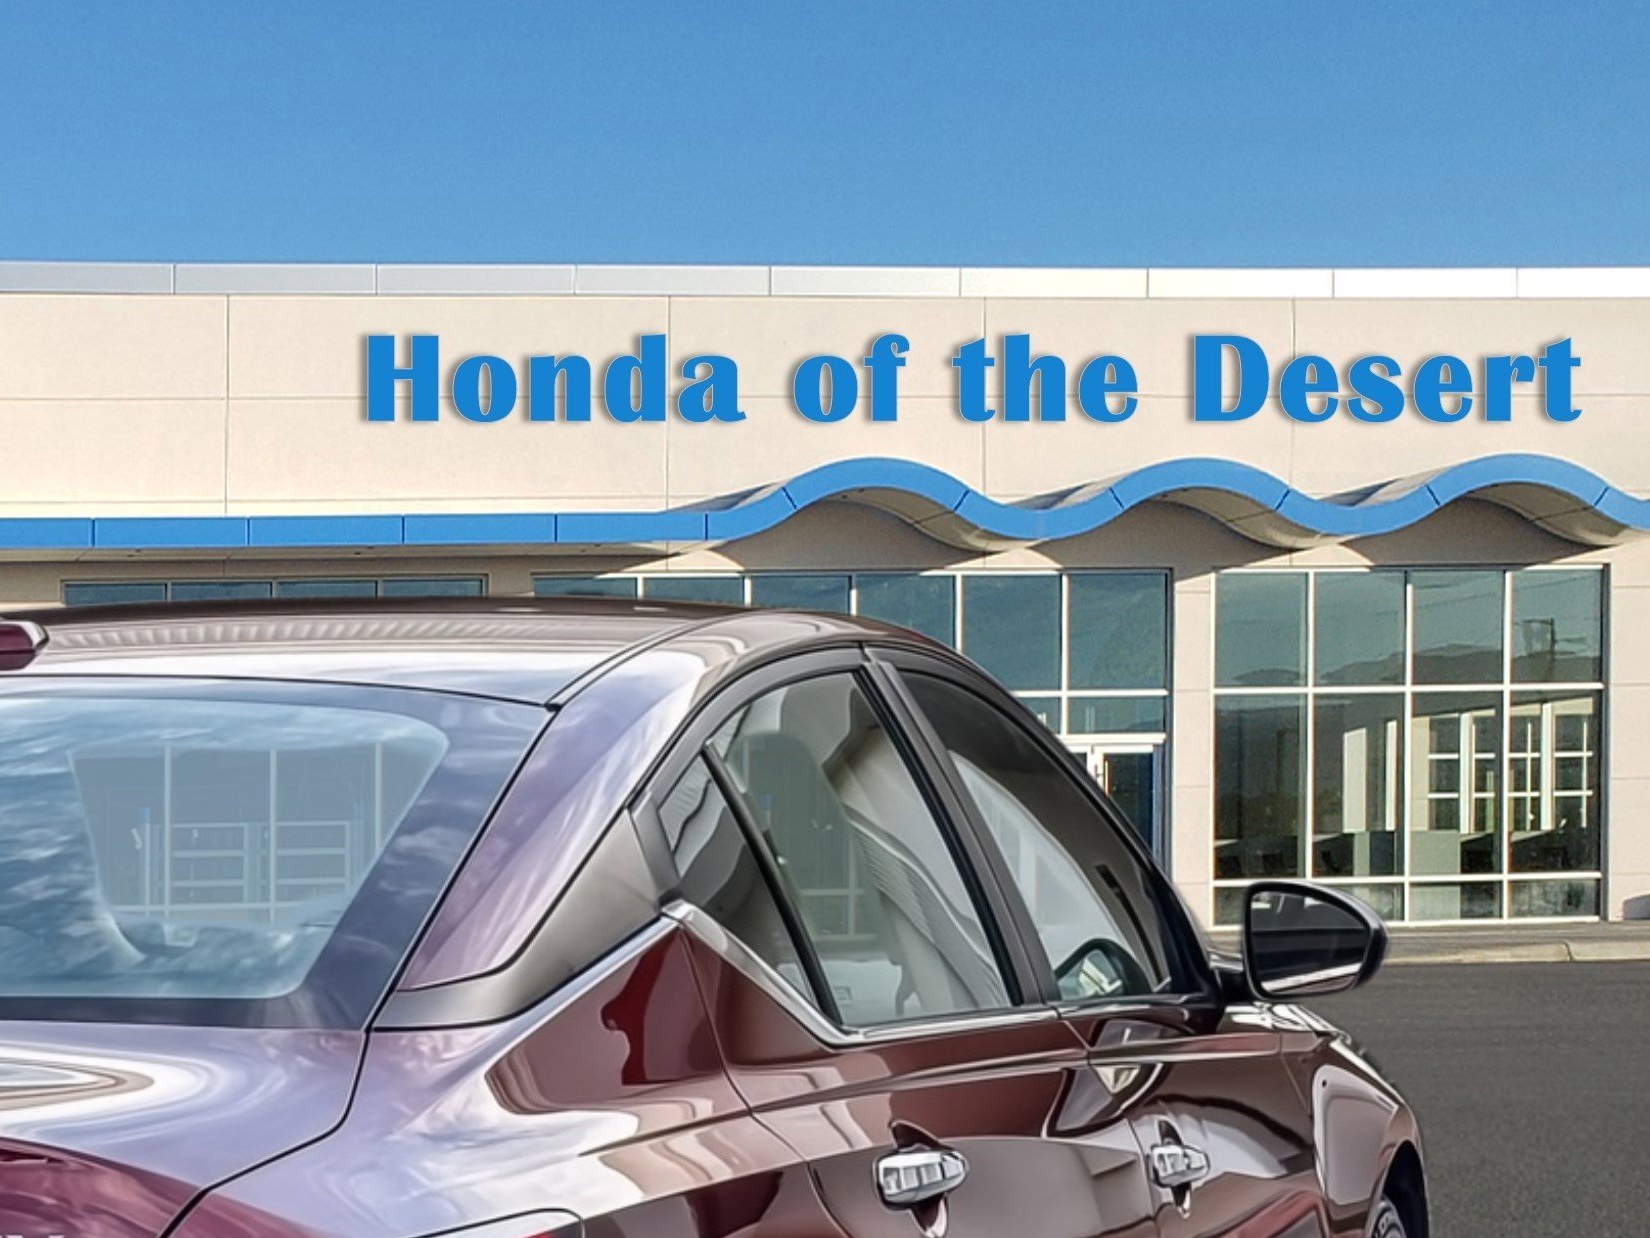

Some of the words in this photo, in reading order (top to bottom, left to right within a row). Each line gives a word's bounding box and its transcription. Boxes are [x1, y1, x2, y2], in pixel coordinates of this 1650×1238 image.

[366, 333, 748, 423] Honda
[793, 332, 912, 423] of
[952, 333, 1139, 424] the
[1194, 334, 1583, 424] Desert
